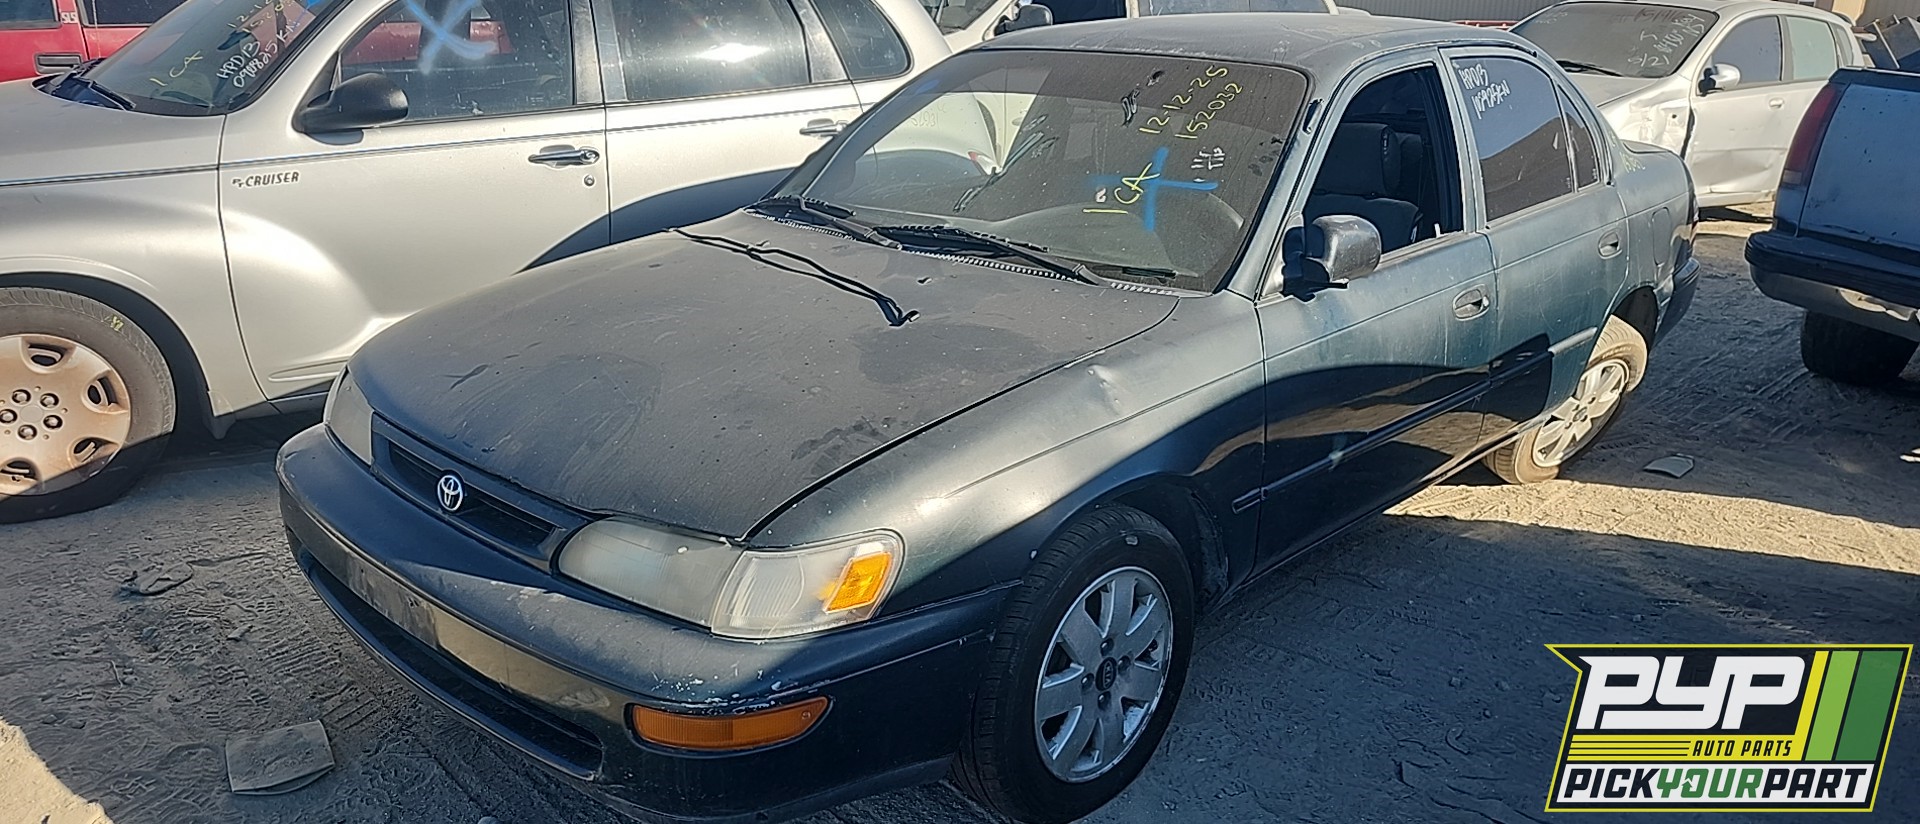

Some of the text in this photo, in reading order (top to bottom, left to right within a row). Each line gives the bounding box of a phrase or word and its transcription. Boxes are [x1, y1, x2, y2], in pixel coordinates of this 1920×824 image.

[1139, 65, 1228, 134] 12-12-25
[1174, 82, 1243, 139] 152032
[245, 171, 299, 187] CRUISER
